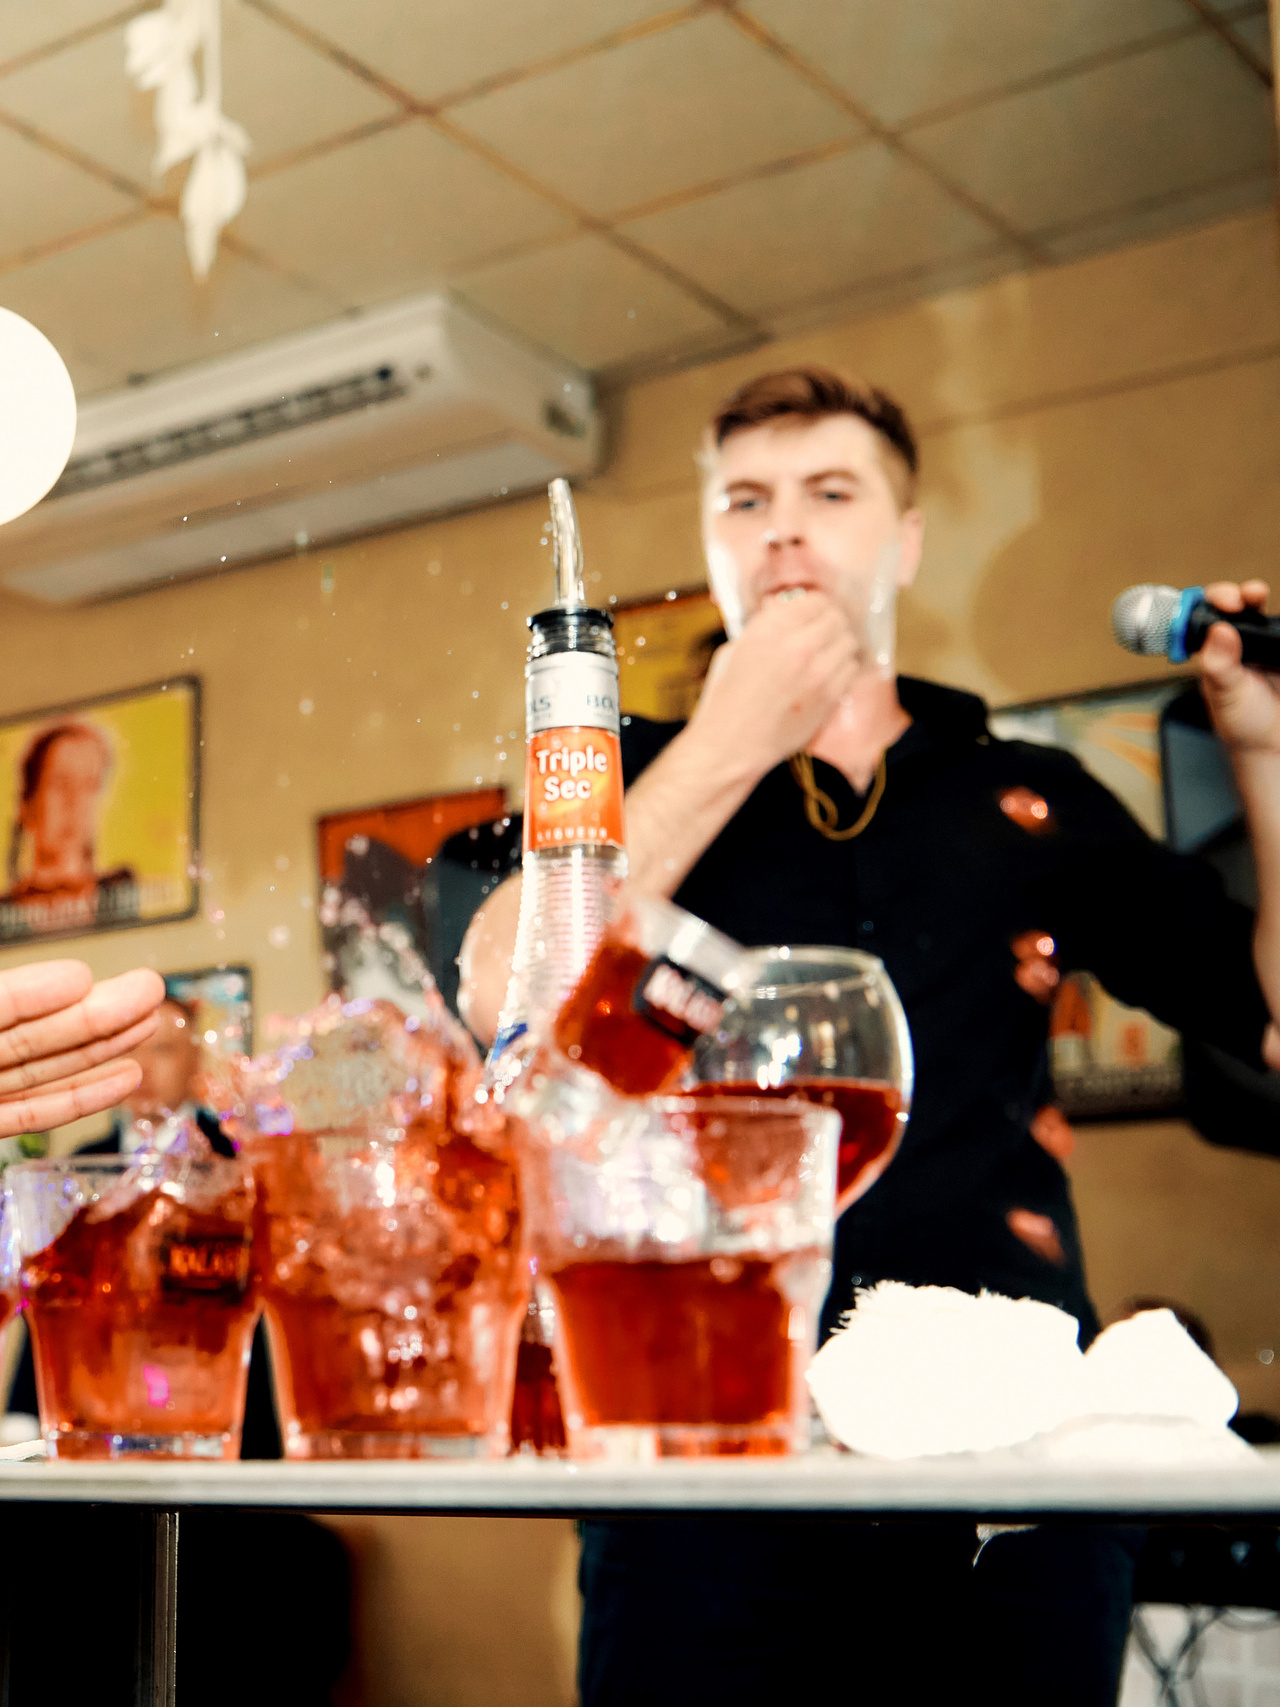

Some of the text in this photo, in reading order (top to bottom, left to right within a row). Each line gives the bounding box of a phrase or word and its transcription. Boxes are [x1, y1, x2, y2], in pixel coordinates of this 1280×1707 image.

[535, 744, 608, 777] Triple
[543, 775, 592, 802] Sec
[536, 825, 608, 842] LIQUEUR
